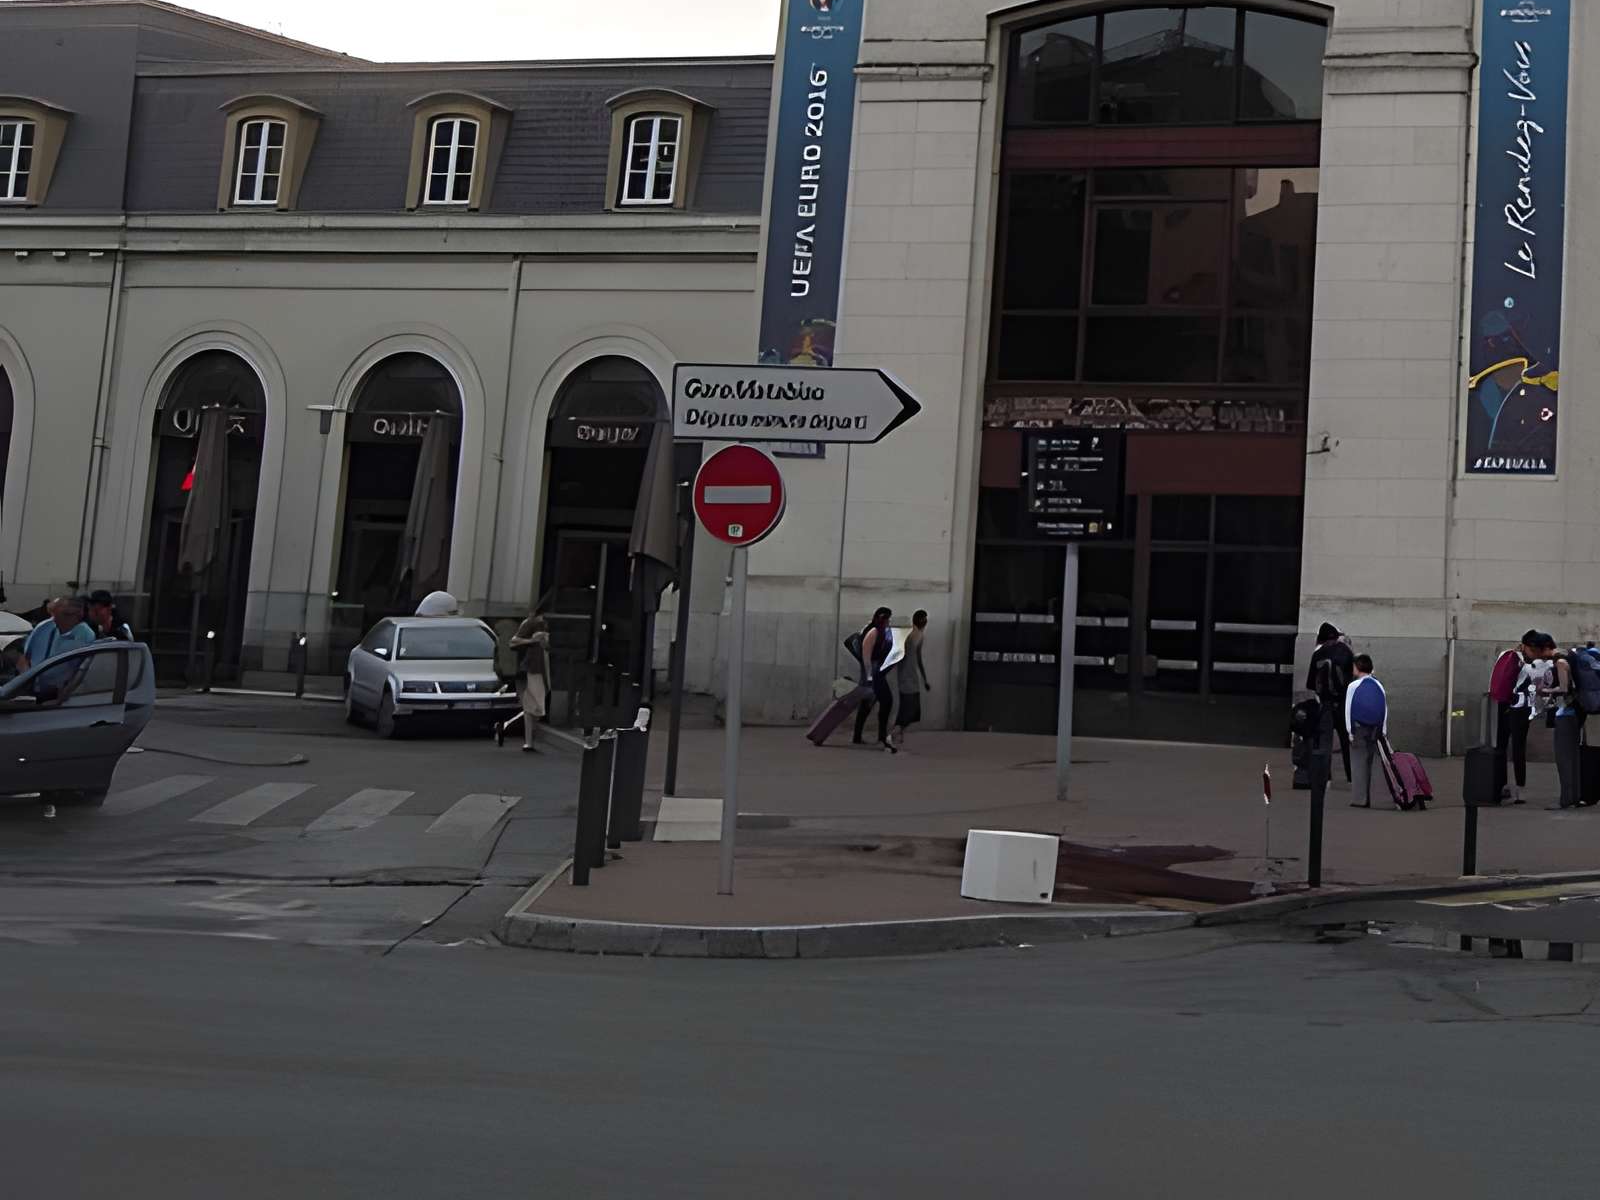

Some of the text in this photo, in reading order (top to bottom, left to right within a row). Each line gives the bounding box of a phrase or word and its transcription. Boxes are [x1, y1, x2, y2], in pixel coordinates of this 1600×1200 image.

[804, 62, 828, 137] 2016
[797, 144, 822, 217] EURO
[790, 223, 816, 297] UEFA
[1503, 242, 1536, 279] Le
